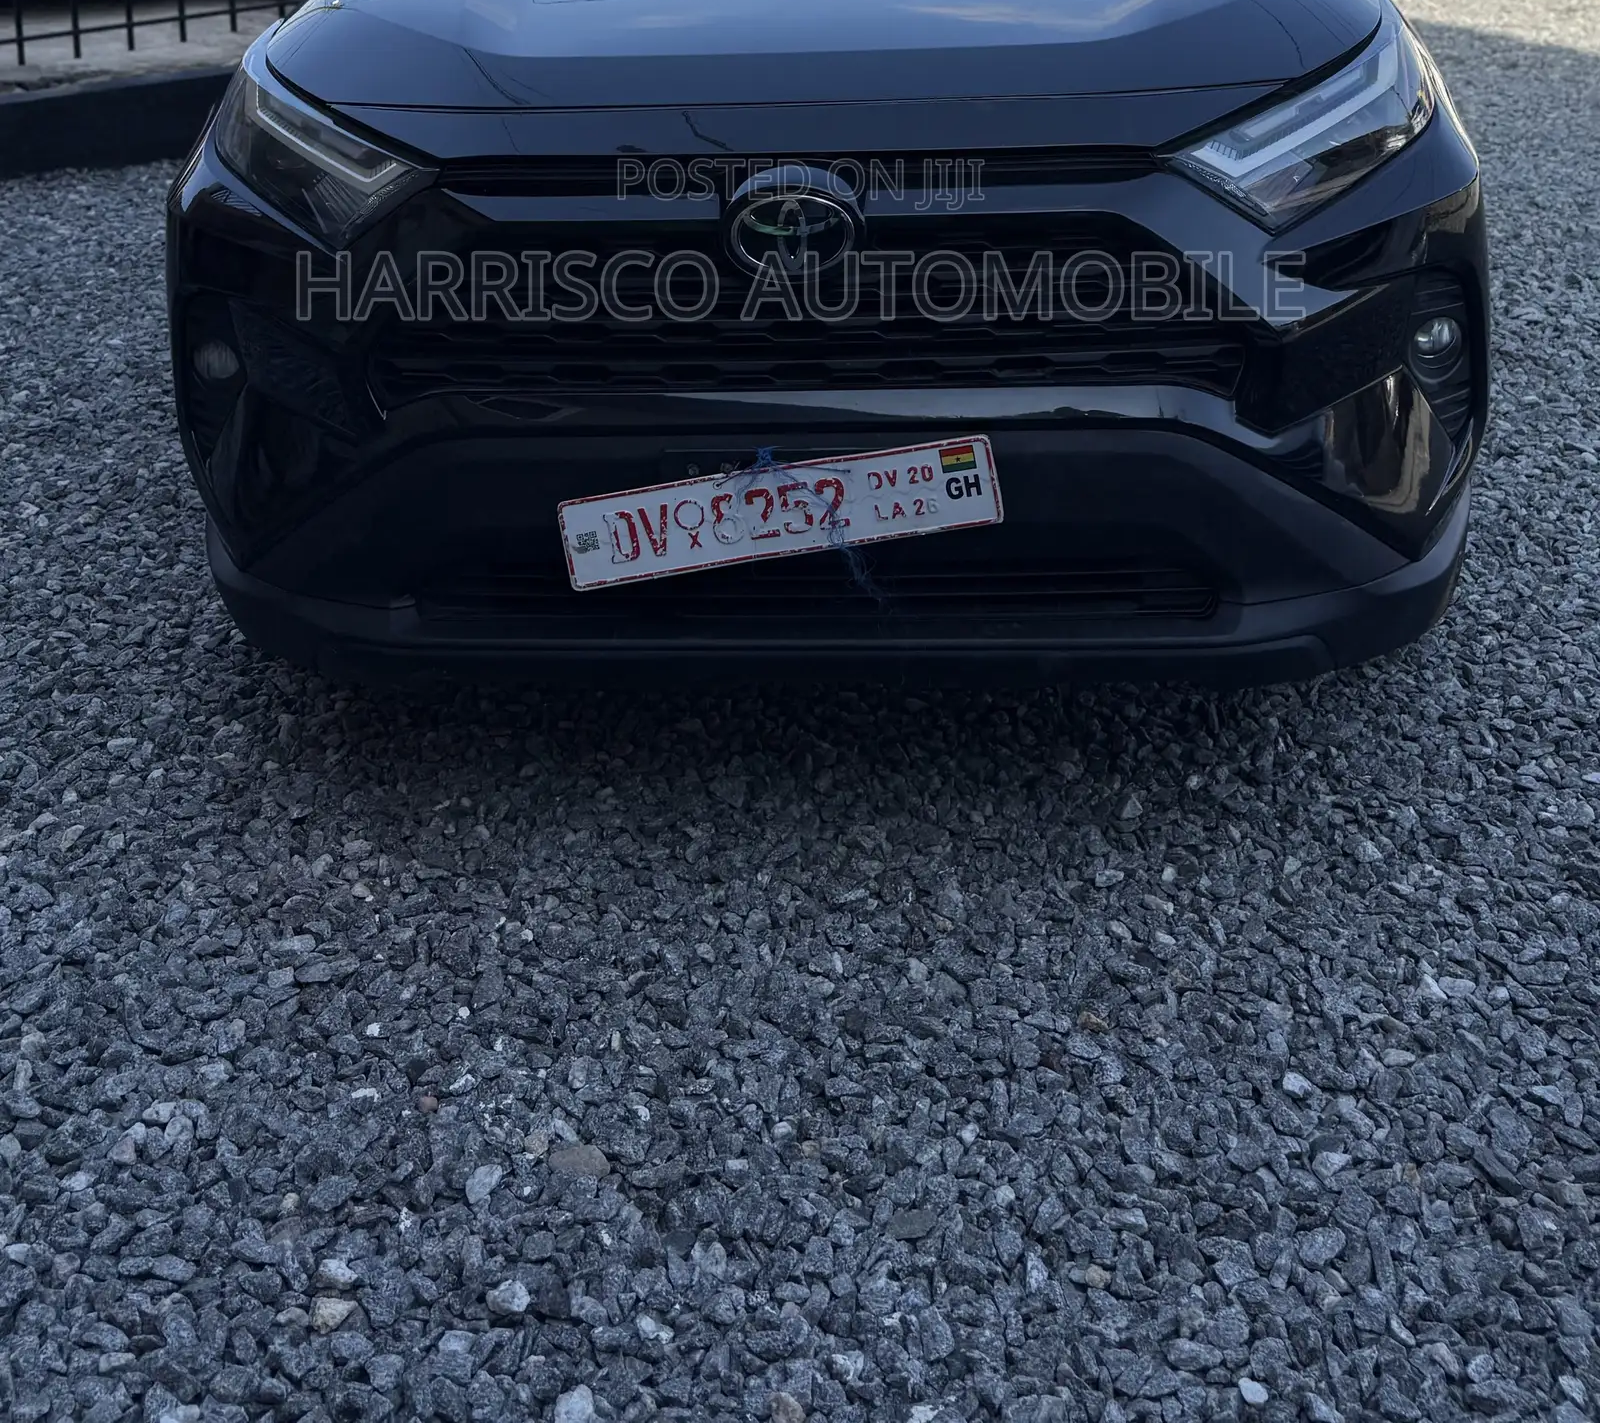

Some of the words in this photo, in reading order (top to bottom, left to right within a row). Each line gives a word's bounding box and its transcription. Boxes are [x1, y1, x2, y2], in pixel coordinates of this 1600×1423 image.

[867, 469, 898, 490] DV
[907, 464, 934, 484] 20
[945, 474, 983, 500] GH
[603, 503, 669, 564] DV
[711, 478, 851, 545] 8252
[874, 502, 907, 521] LA
[912, 498, 939, 516] 26
